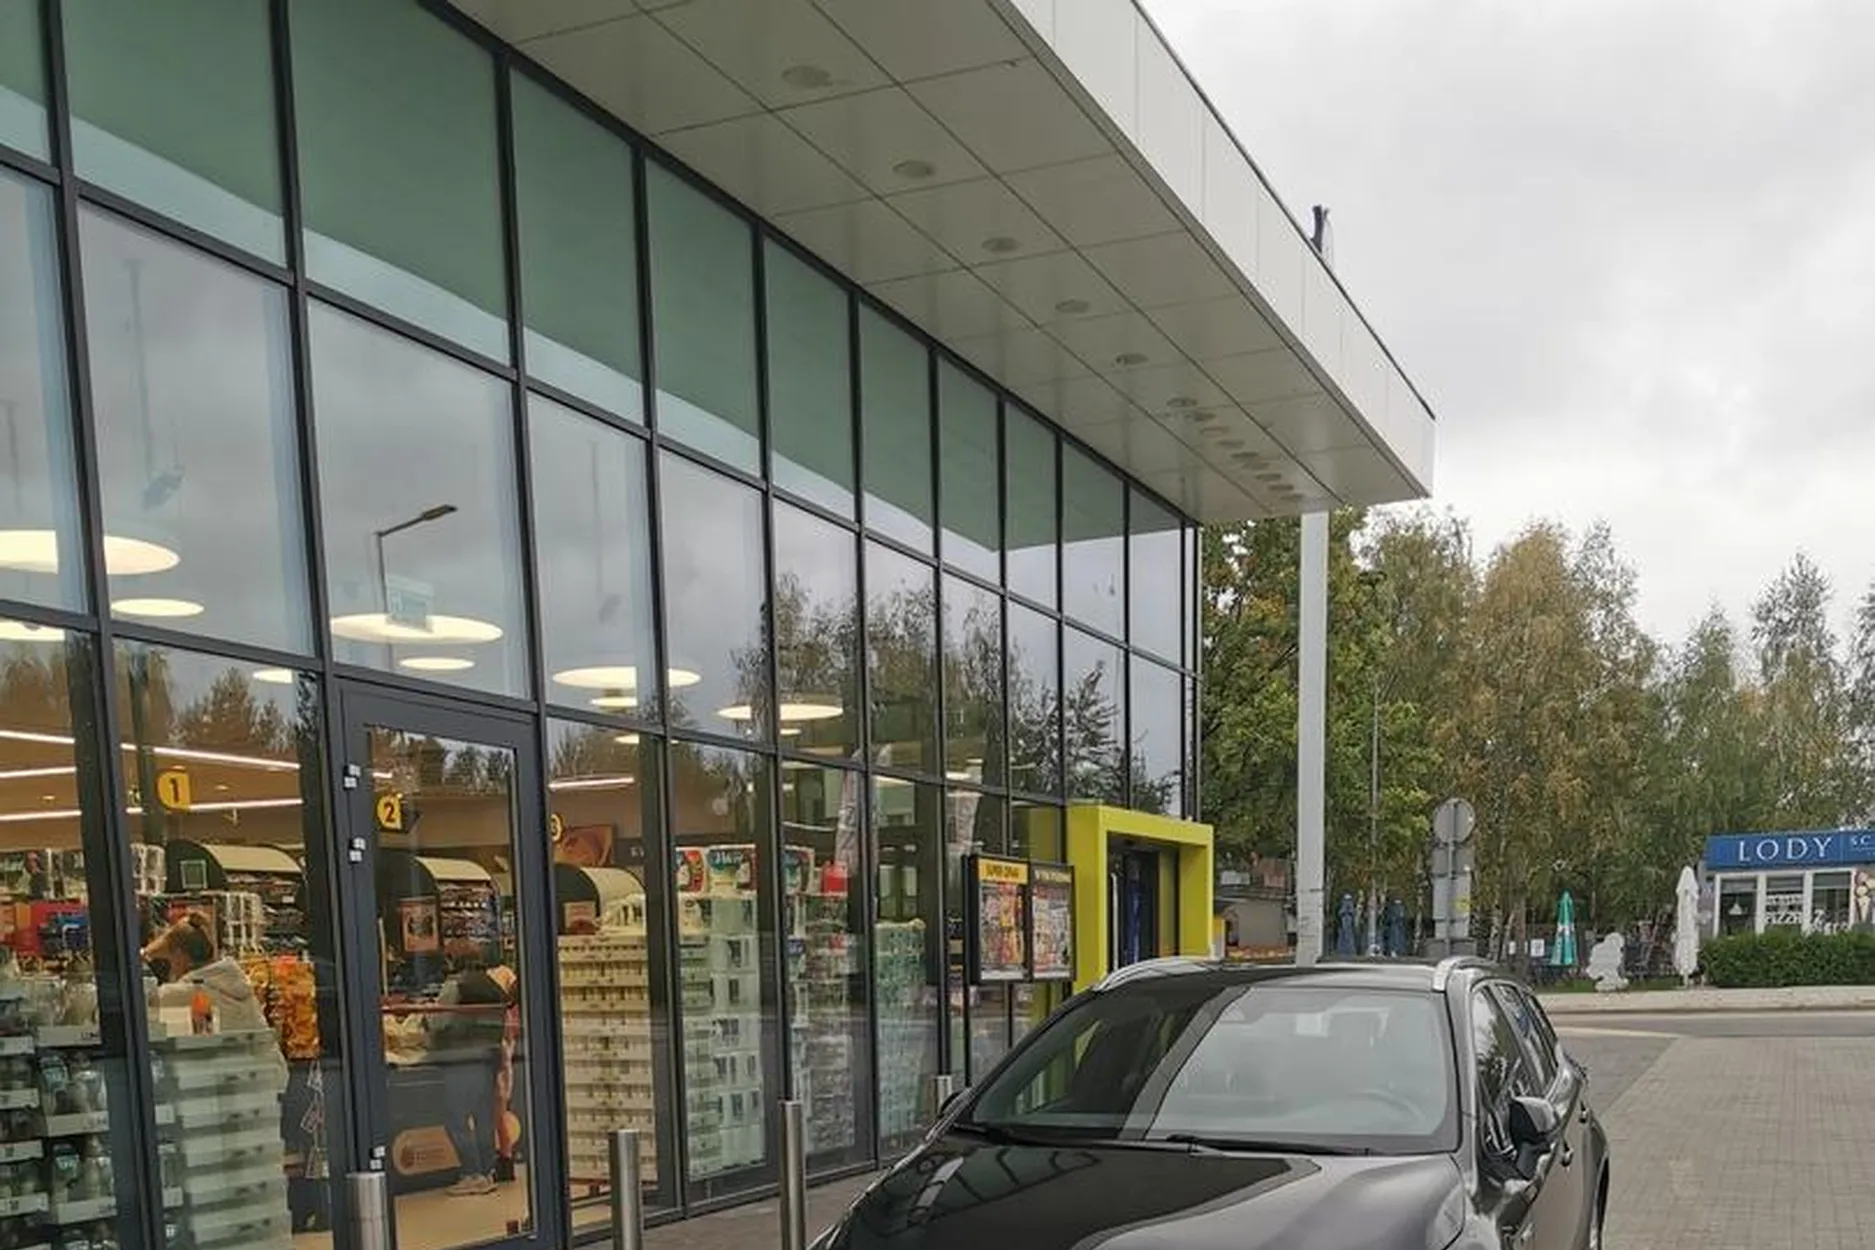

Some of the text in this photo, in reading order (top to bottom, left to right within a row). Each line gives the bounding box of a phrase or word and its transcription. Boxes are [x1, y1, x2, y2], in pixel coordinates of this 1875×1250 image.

[170, 778, 180, 803] 1
[383, 802, 396, 823] 2
[1738, 837, 1833, 863] LODY
